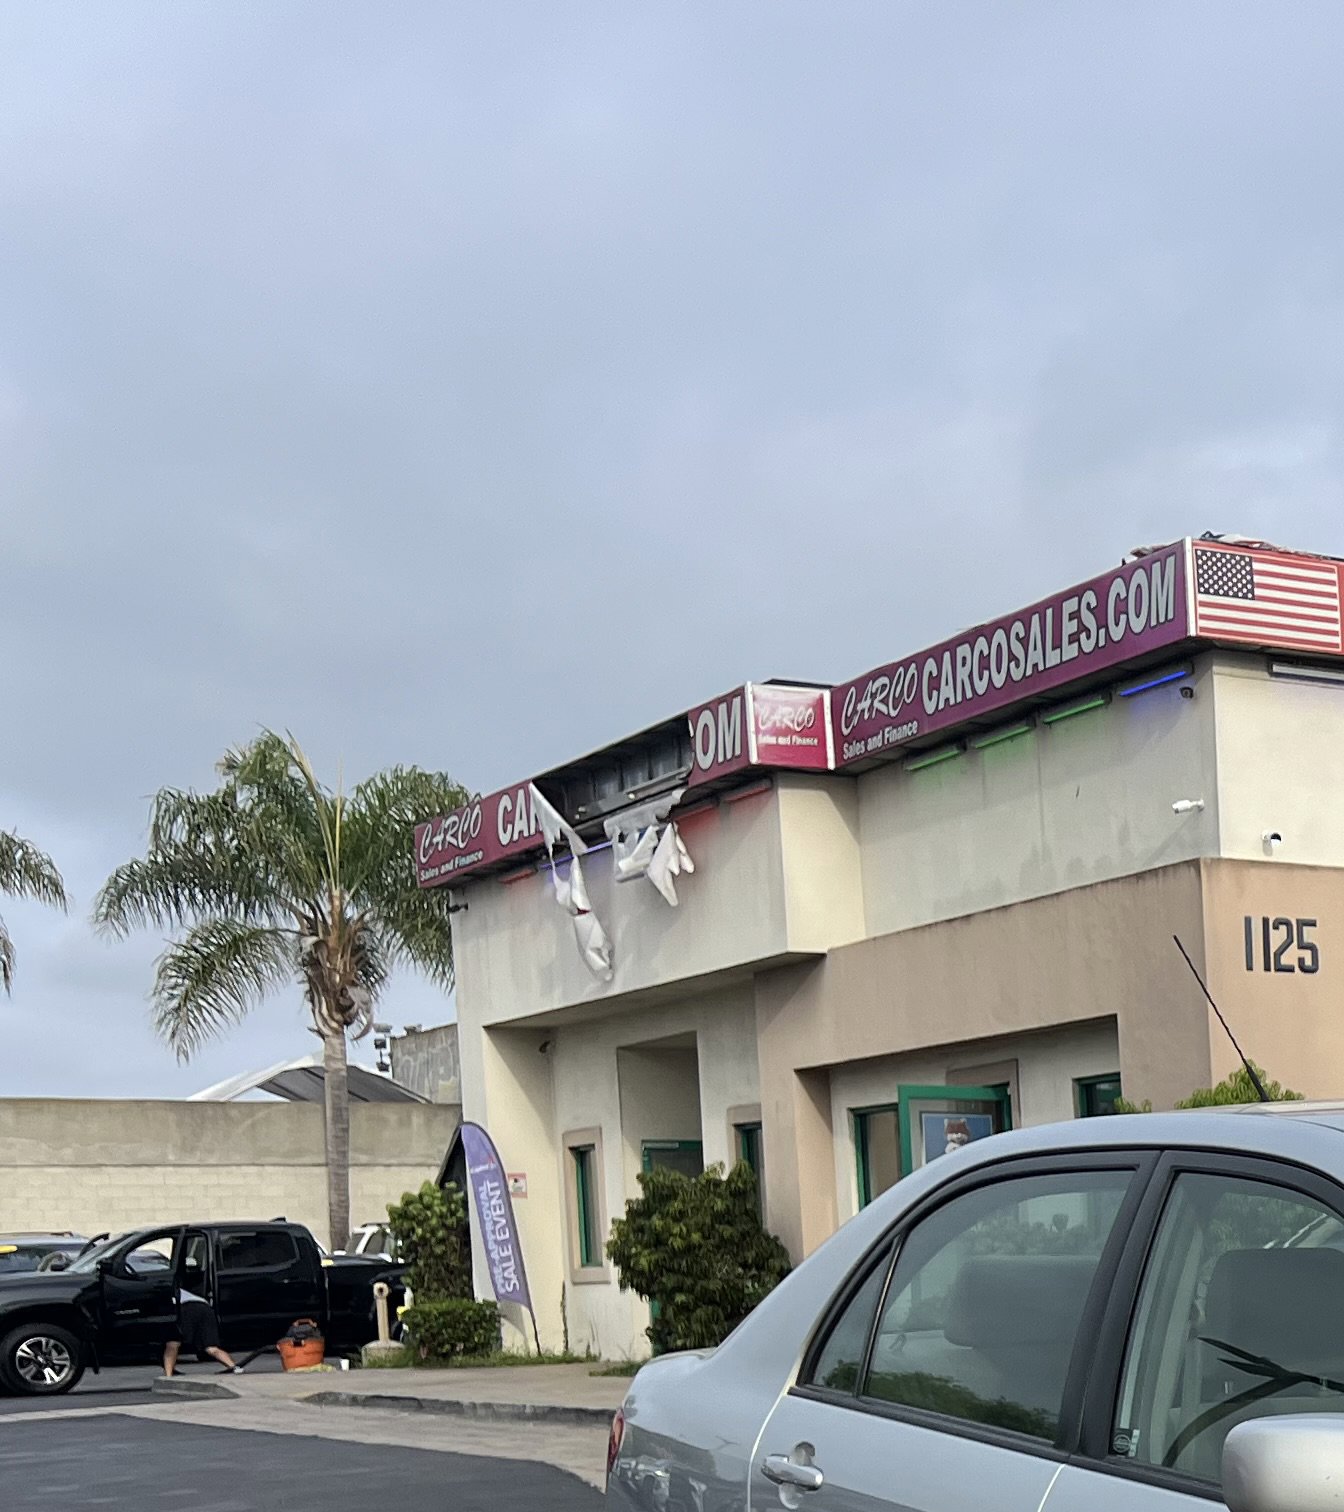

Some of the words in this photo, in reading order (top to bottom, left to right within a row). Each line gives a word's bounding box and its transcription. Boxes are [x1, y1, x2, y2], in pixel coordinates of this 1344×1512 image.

[922, 554, 1176, 715] CARCOSALES.COM
[757, 704, 816, 732] CARCO
[841, 662, 917, 736] CARCO
[688, 695, 742, 773] OM
[843, 740, 865, 760] Sales
[867, 729, 883, 751] and
[884, 719, 918, 744] Finance
[420, 804, 482, 864] CARCO
[1244, 916, 1319, 973] 1125
[486, 1180, 510, 1241] EVENT
[500, 1244, 520, 1292] SALE
